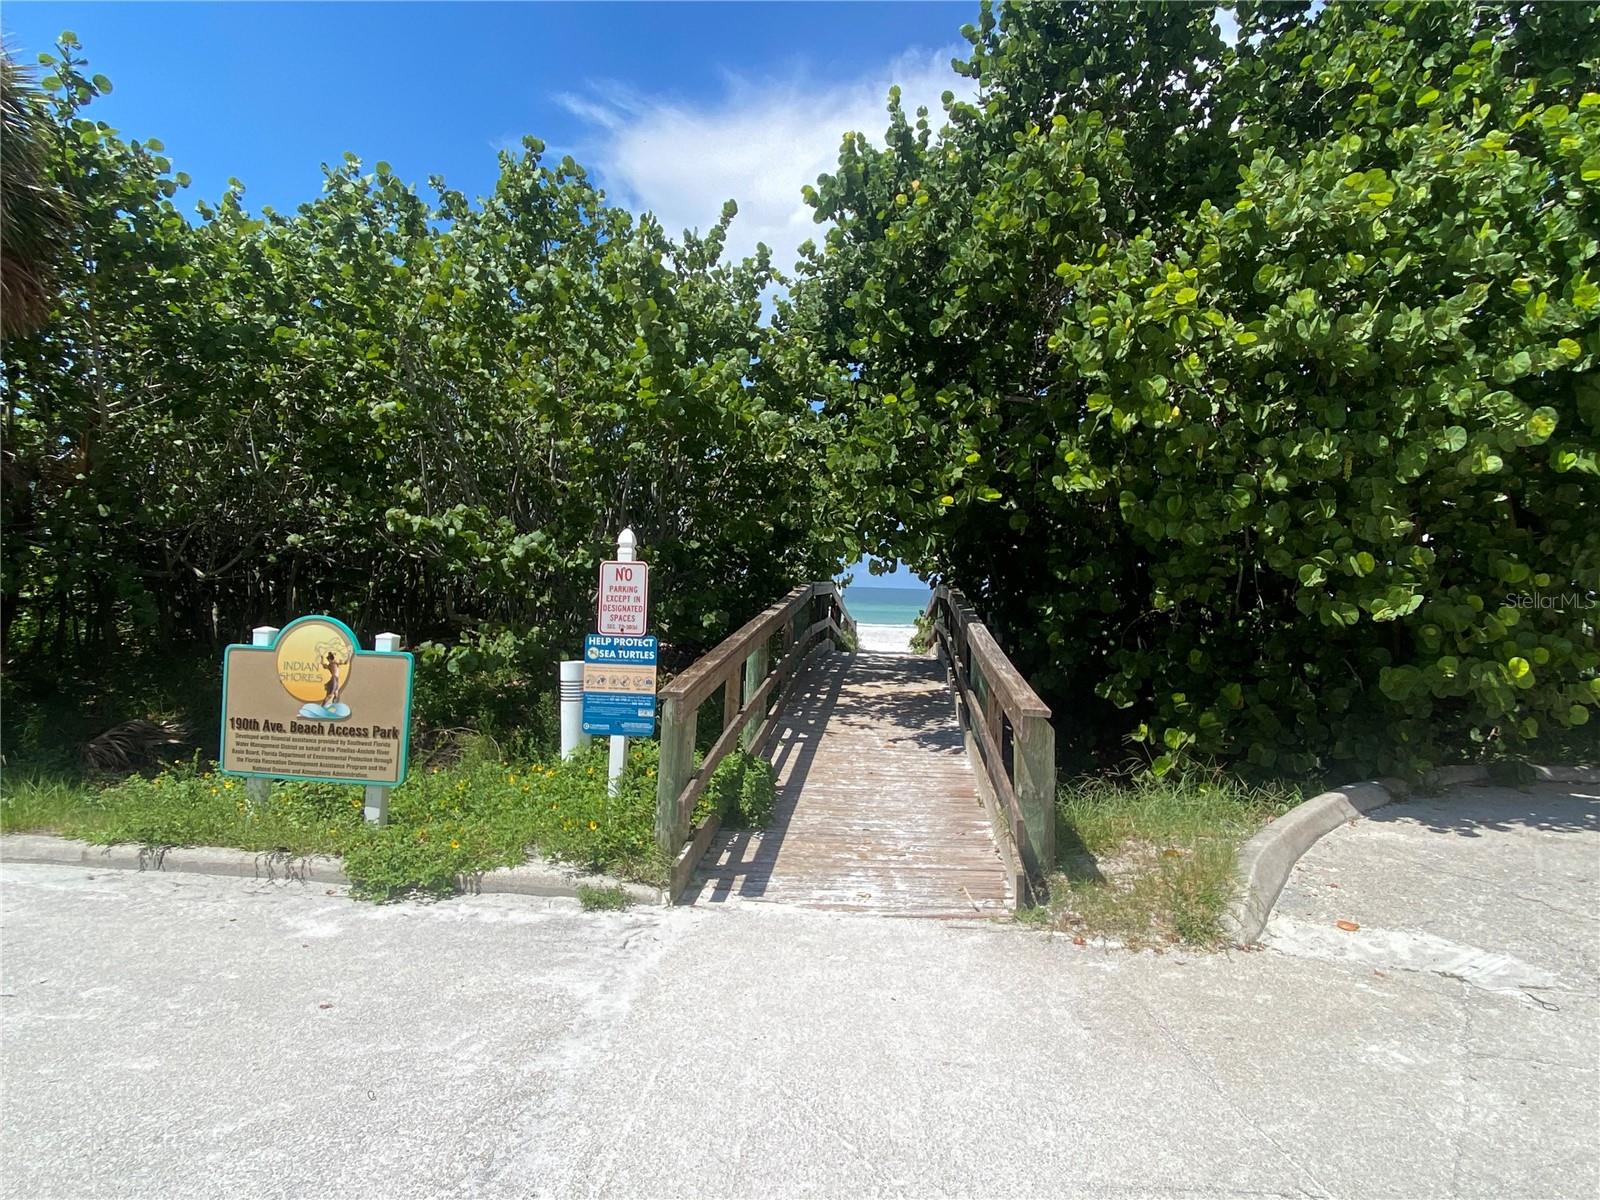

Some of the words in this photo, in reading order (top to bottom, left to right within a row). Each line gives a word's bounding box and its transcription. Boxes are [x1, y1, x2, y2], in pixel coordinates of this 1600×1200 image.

[615, 567, 633, 581] NO
[609, 585, 639, 594] PARKING
[606, 594, 630, 602] EXCEPT
[603, 604, 643, 613] DESIGNATED
[610, 614, 636, 622] SPACES
[588, 636, 612, 646] HELP
[614, 637, 654, 647] PROTECT
[599, 650, 616, 658] SEA
[618, 650, 654, 659] TURTLES
[283, 660, 320, 672] INDIAN
[279, 672, 323, 683] SHORES
[230, 716, 260, 732] 190th
[262, 719, 287, 734] Ave.
[290, 720, 324, 735] Beach
[328, 723, 369, 737] Access
[372, 725, 400, 739] Park
